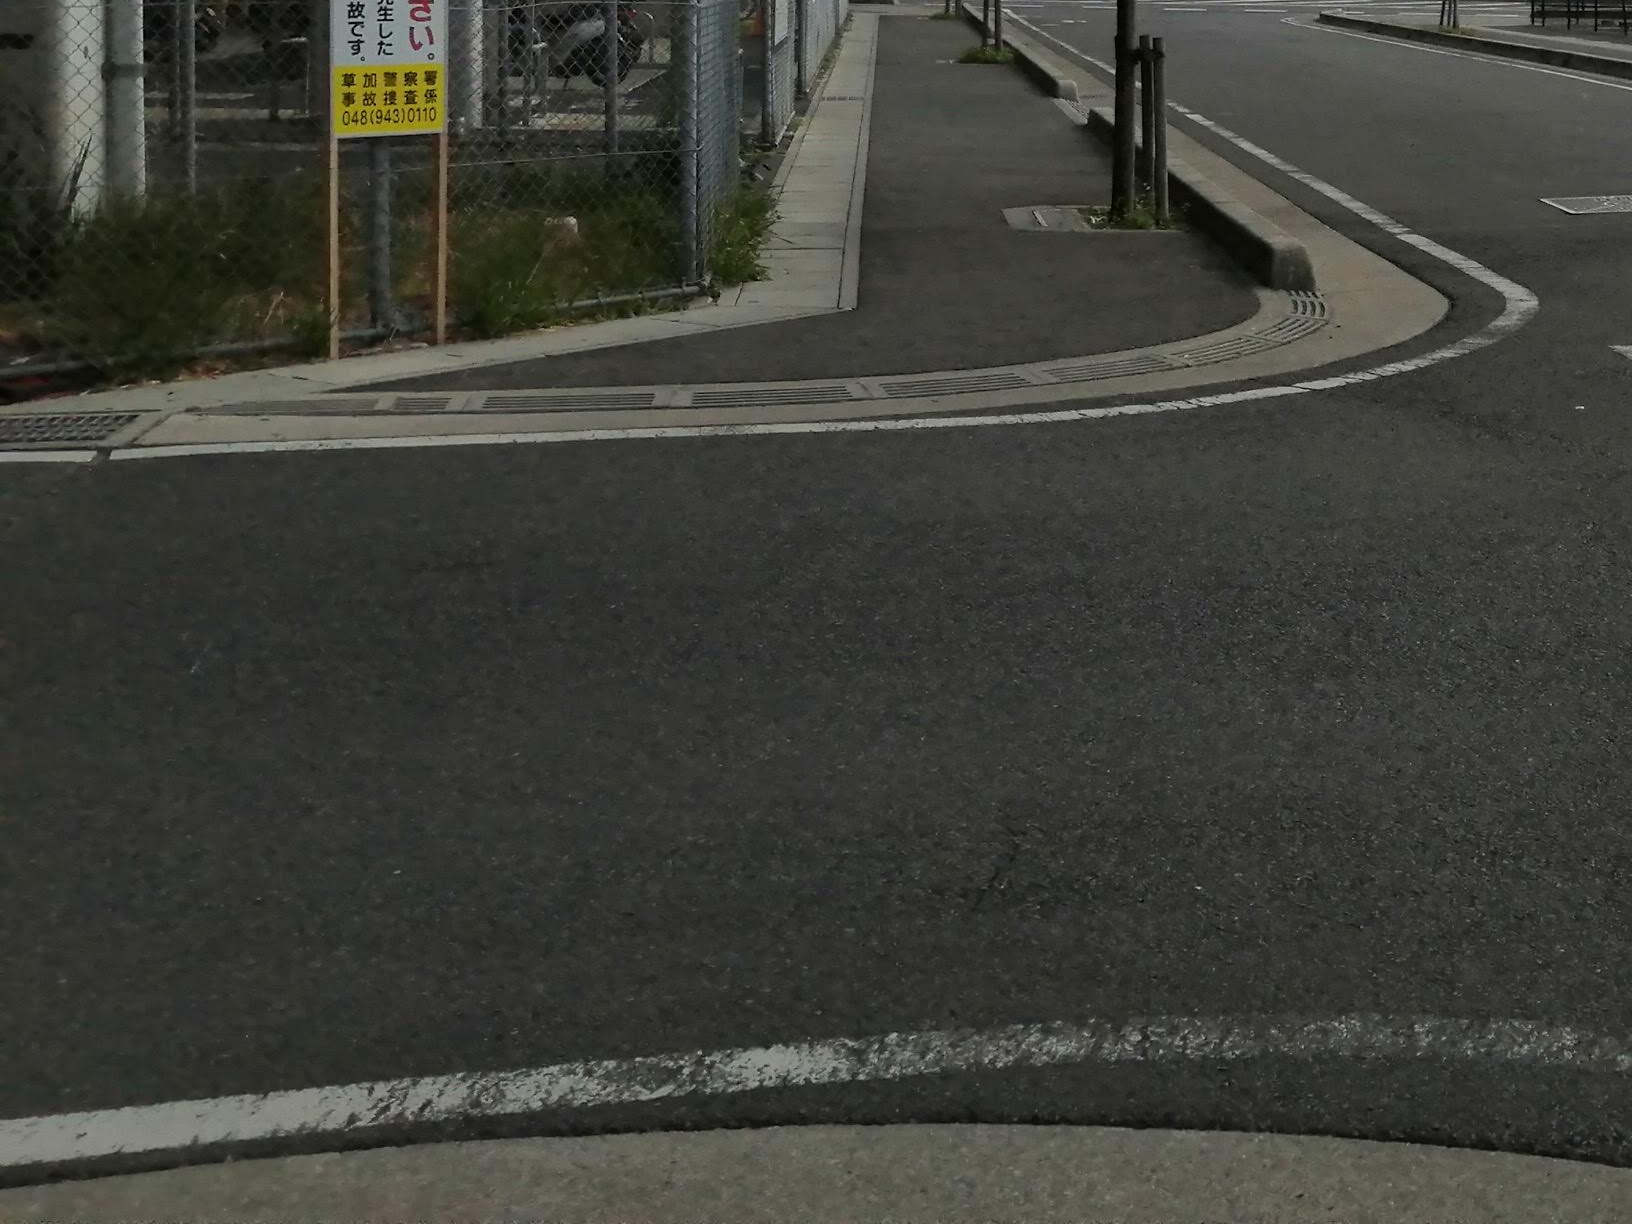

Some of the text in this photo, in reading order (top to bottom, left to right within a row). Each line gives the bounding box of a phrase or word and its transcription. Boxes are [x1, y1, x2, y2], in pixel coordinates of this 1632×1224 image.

[341, 70, 438, 88] 草加警察署
[341, 88, 438, 107] 事故捜査係
[342, 106, 437, 126] 048(943)0110
